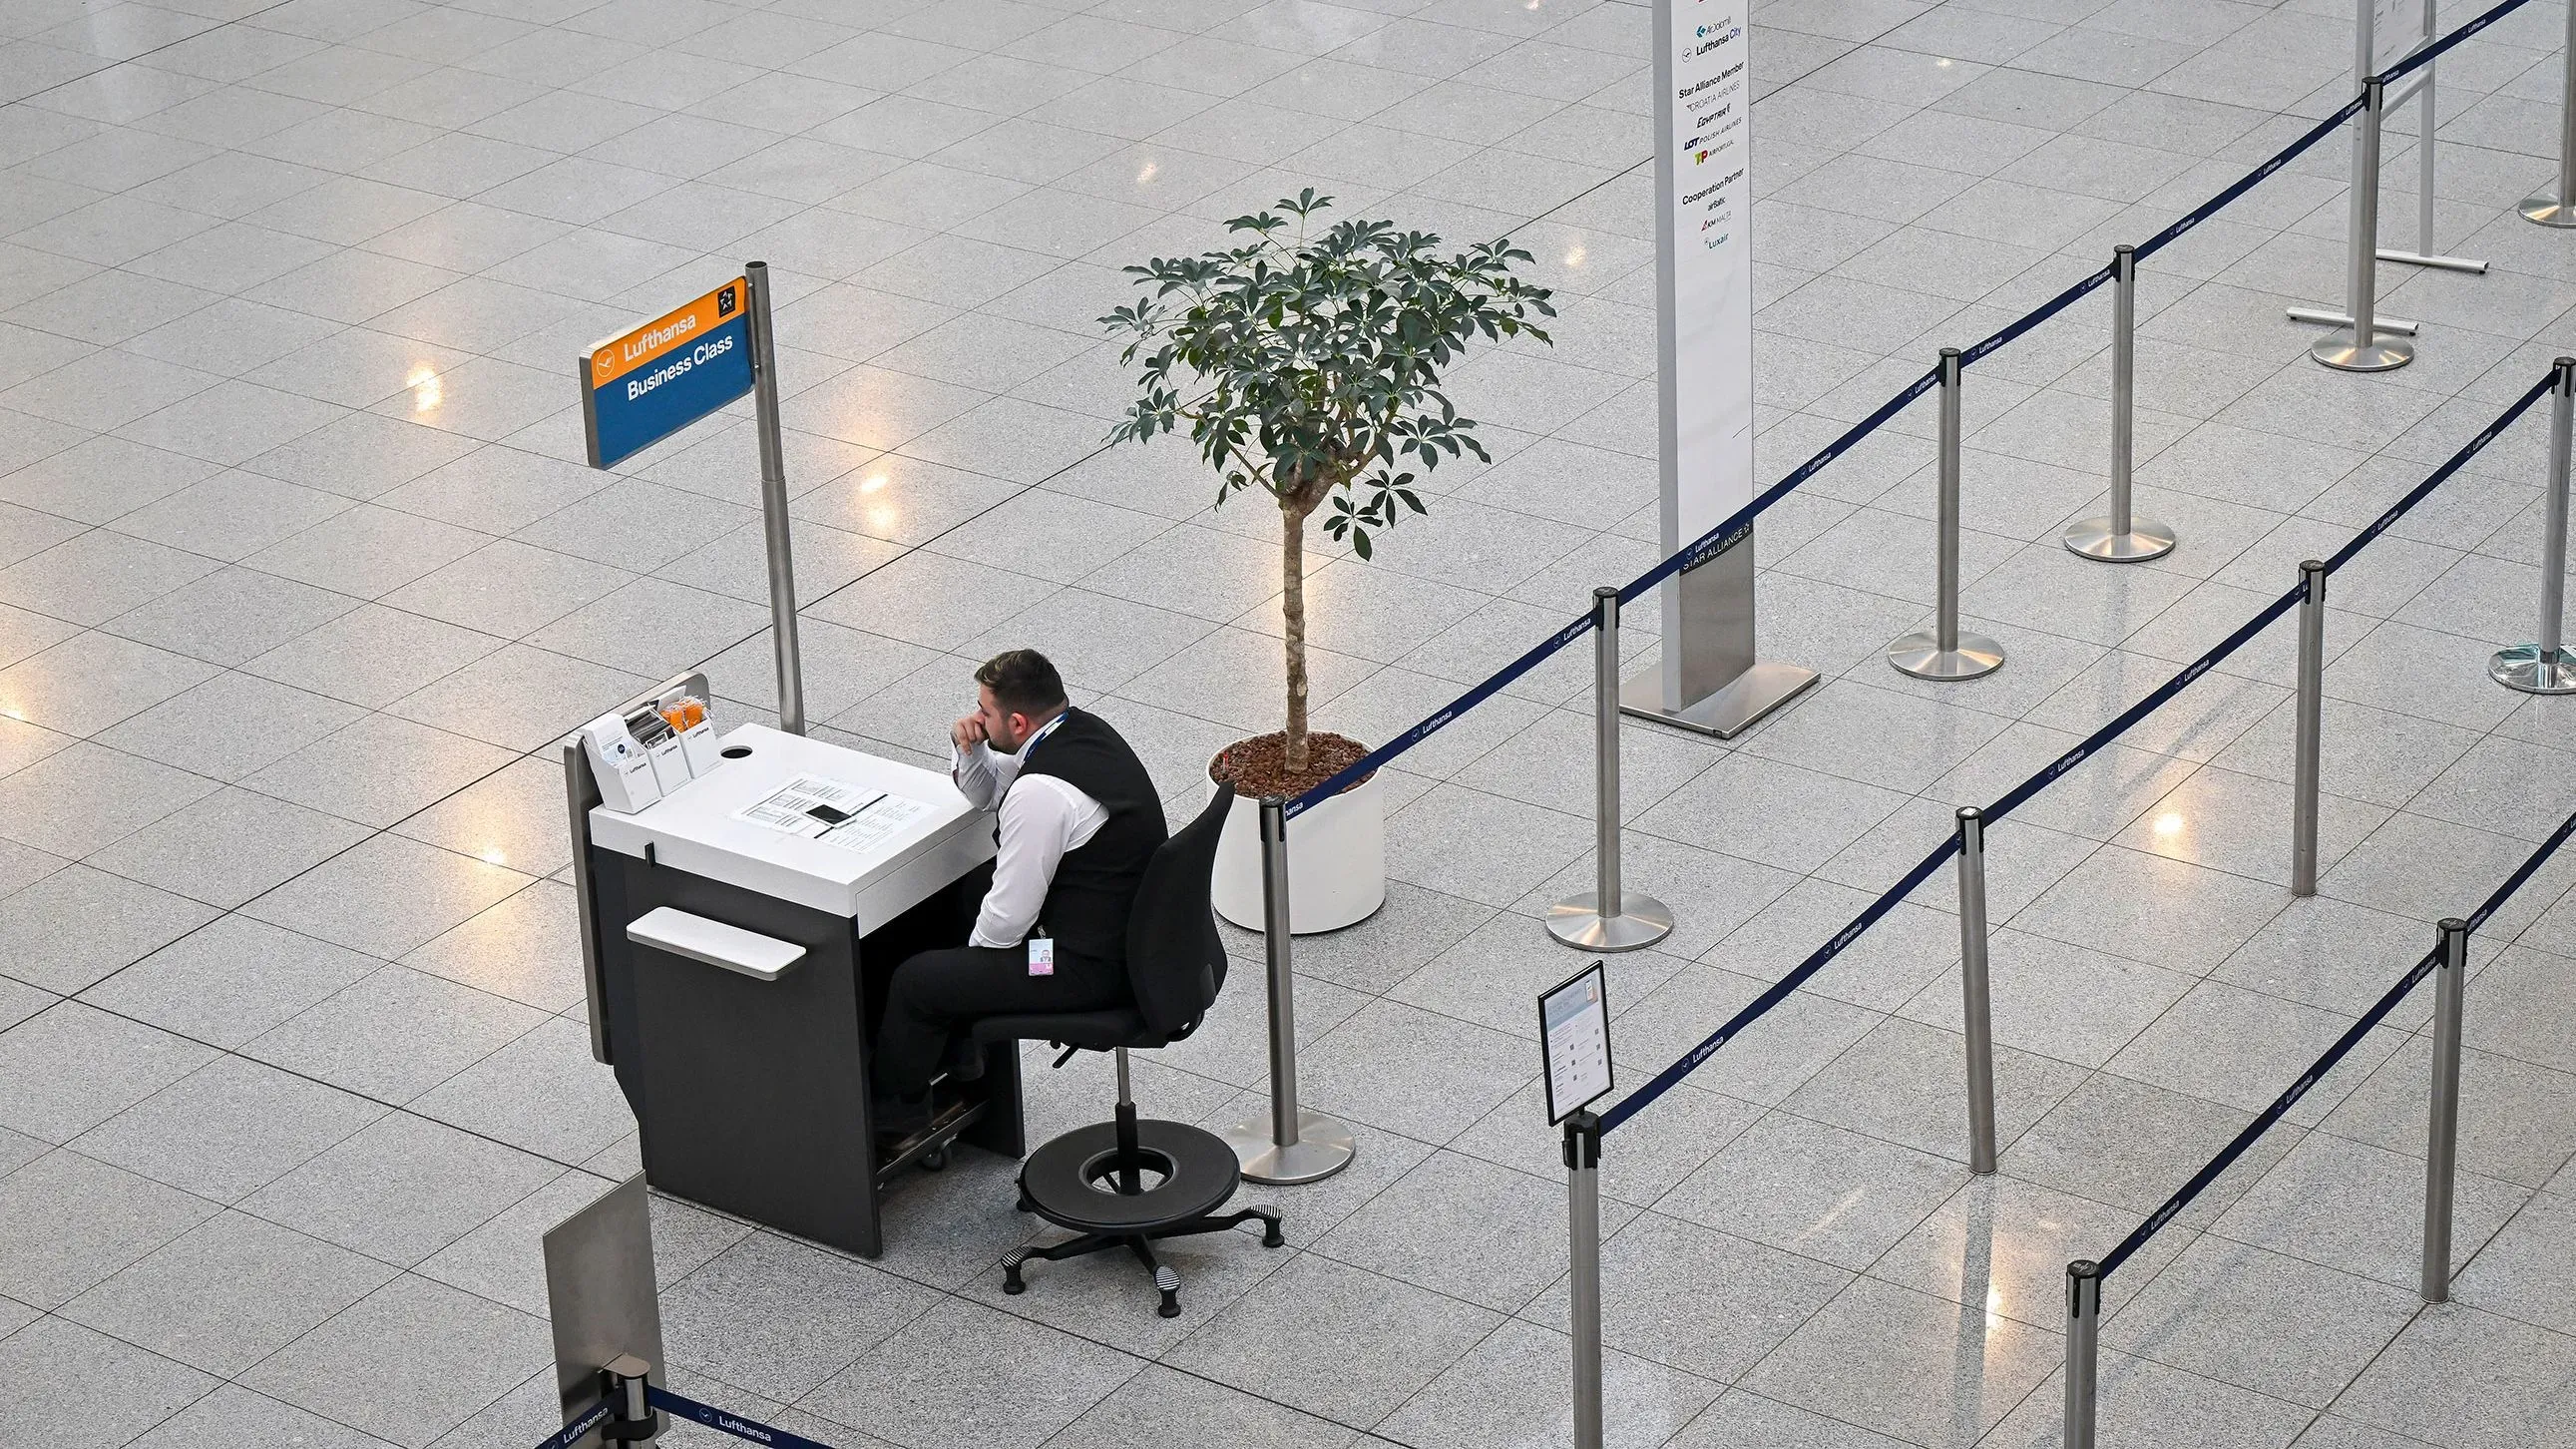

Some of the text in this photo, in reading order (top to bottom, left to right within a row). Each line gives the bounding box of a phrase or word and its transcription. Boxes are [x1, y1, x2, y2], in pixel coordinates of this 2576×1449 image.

[1696, 34, 1729, 56] Lufthansa
[1678, 61, 1744, 99] Star Alliance Member
[1683, 136, 1700, 151] LOT
[1699, 129, 1720, 145] POLISH
[1682, 168, 1744, 205] Cooperation Partner
[1708, 233, 1729, 249] Luxair
[624, 313, 696, 362] Lufthansa
[1978, 335, 2003, 354] Lufthansa
[627, 334, 733, 401] Business Class
[1914, 373, 1937, 395] Lufthansa
[1808, 451, 1832, 473] Lufthansa
[1695, 532, 1721, 553] Lufthansa
[1706, 527, 1744, 559] ALLIANCE
[1562, 617, 1592, 642] Lufthansa
[2183, 658, 2211, 683] Lufthansa
[1422, 710, 1453, 734] Lufthansa
[2057, 747, 2085, 772] Lufthansa
[1833, 921, 1863, 950] Lufthansa
[1691, 1034, 1725, 1064] Lufthansa
[2150, 1200, 2180, 1230] Lufthansa
[563, 1406, 609, 1445] Lufthansa
[718, 1415, 772, 1442] Lufthansa
